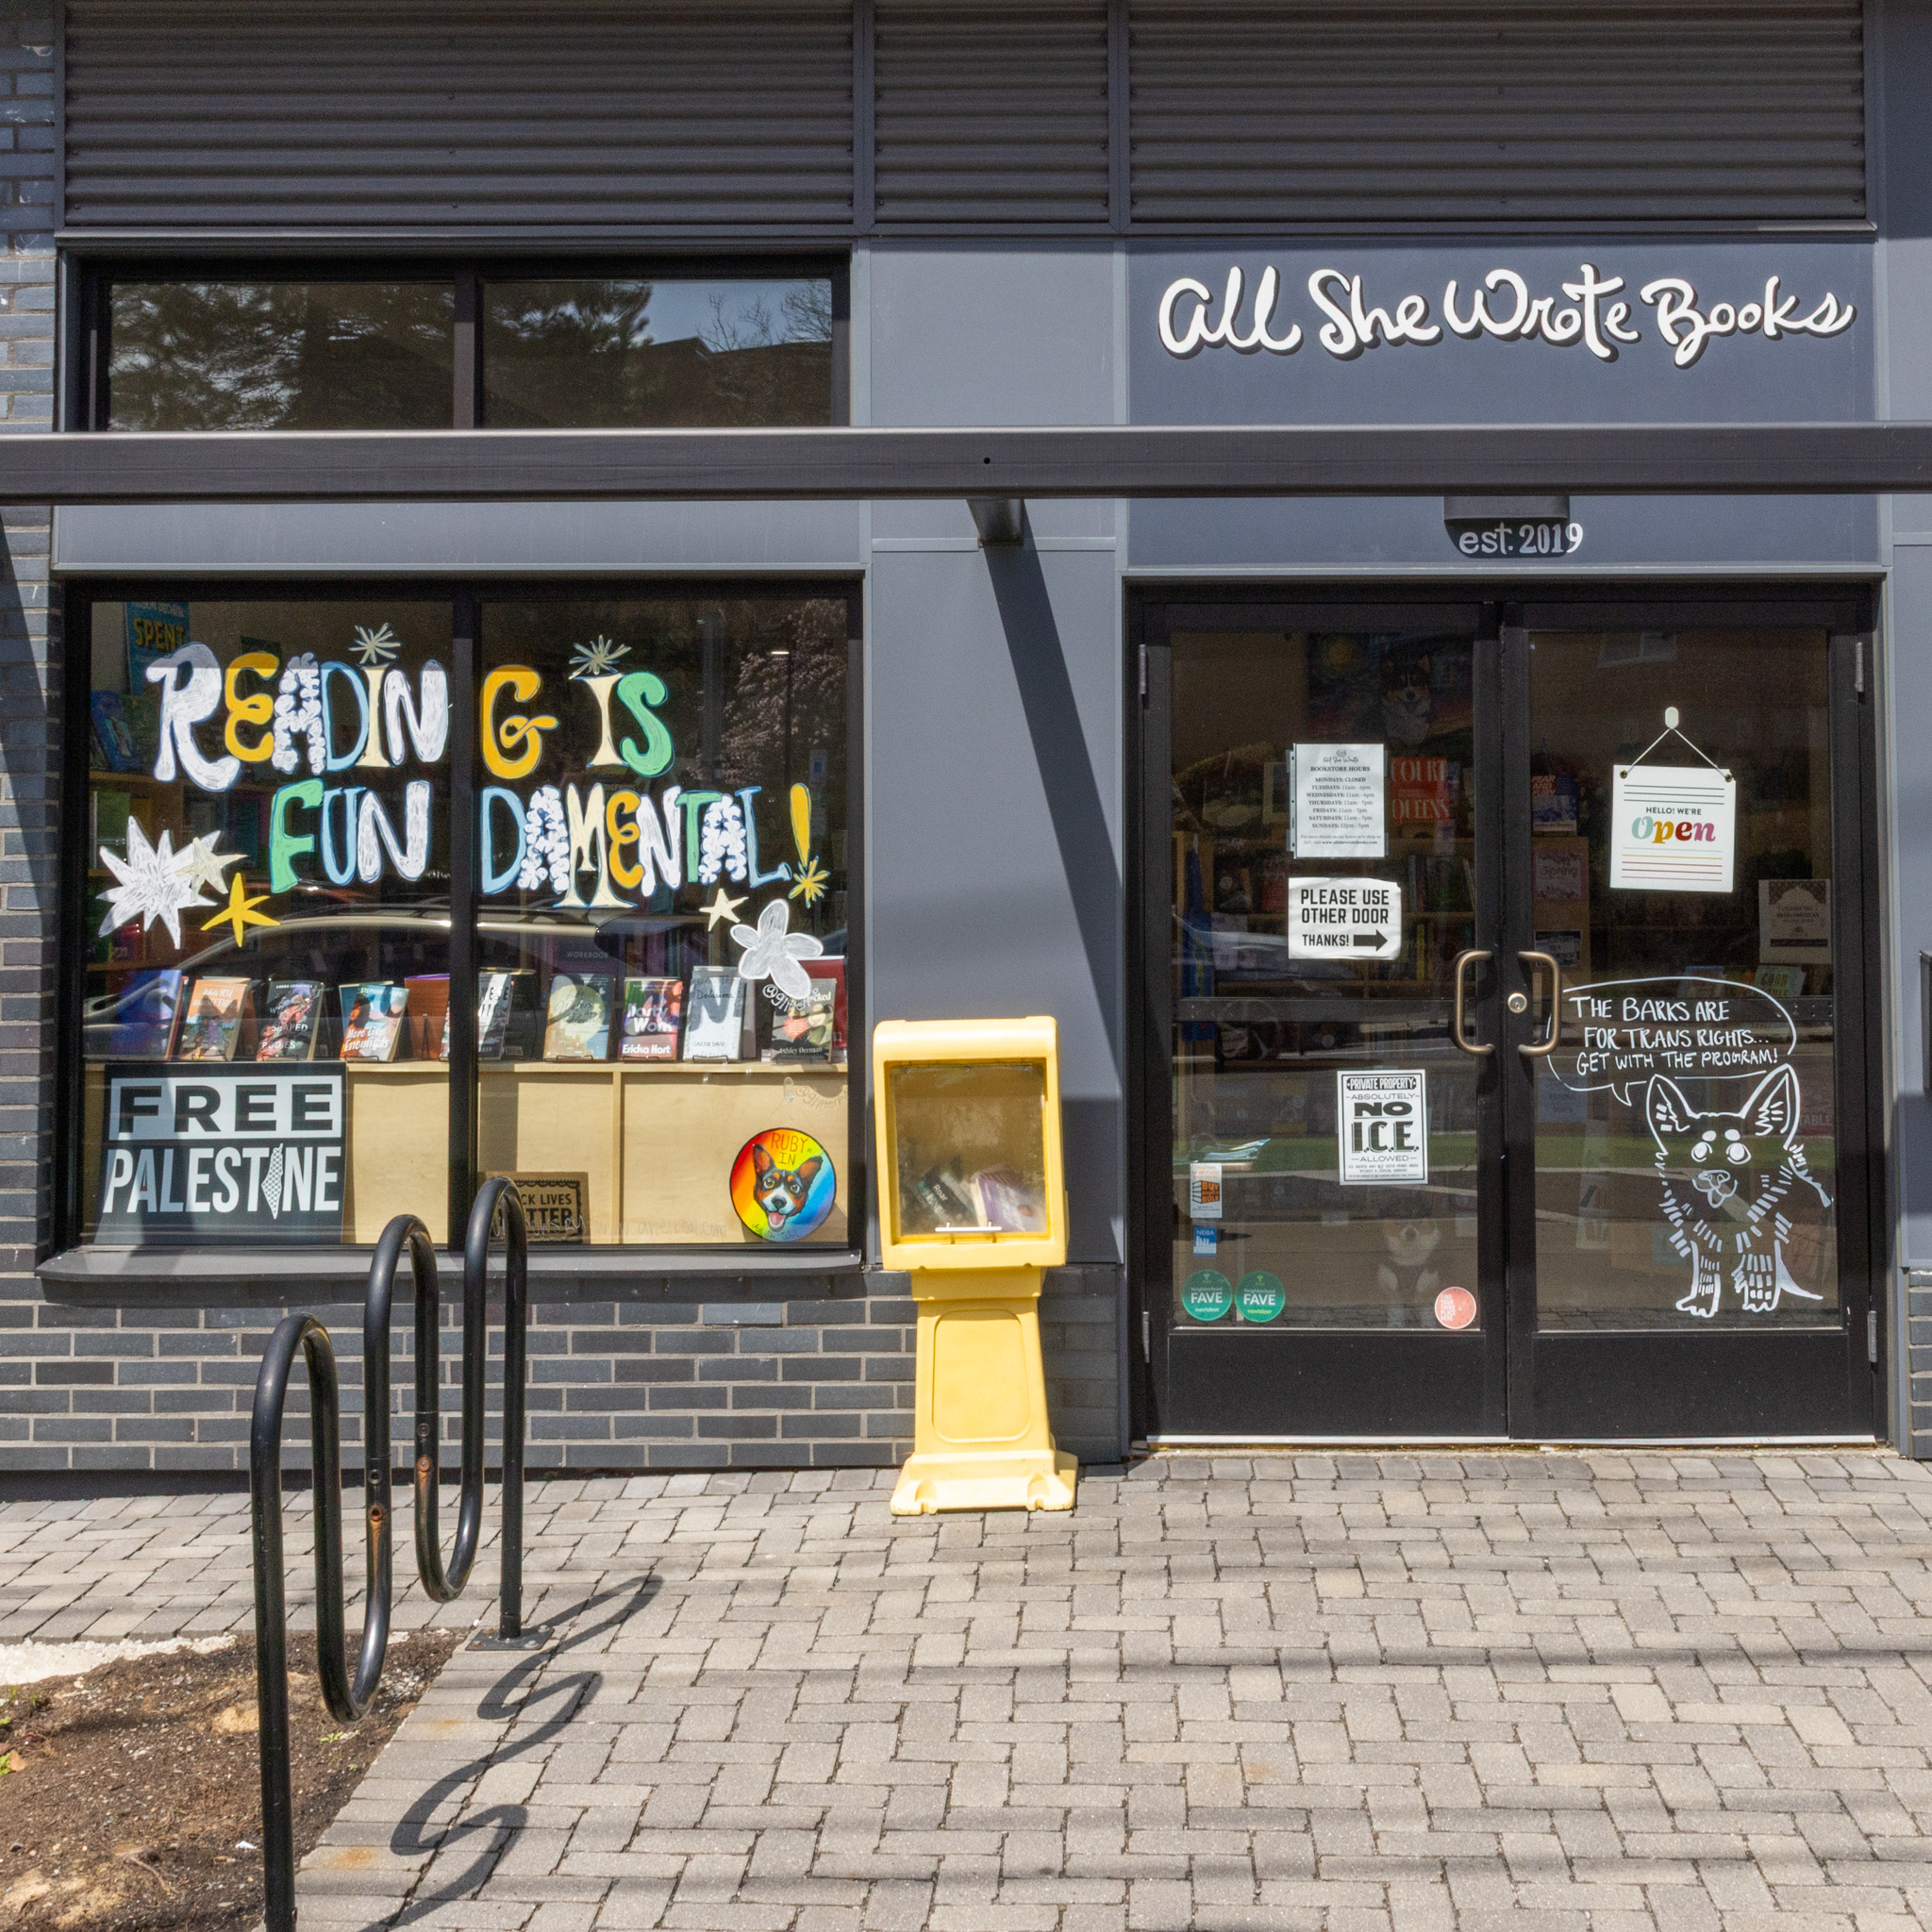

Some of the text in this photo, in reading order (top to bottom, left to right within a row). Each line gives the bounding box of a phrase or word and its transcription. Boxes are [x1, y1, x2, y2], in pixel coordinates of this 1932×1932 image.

[1308, 268, 1442, 359] She
[1443, 264, 1641, 361] Wrote
[1641, 275, 1856, 368] Books
[1457, 522, 1584, 556] est. 2019
[133, 616, 185, 653] SPENT
[568, 670, 675, 778] IS
[1645, 807, 1675, 815] HELLO!
[1631, 816, 1716, 844] Open
[1301, 889, 1390, 906] PLEASE USE
[1301, 908, 1389, 924] OTHER DOOR
[1302, 934, 1349, 946] THANKS!
[1569, 996, 1730, 1022] THE BARKS ARE
[346, 1029, 366, 1040] More
[1584, 1026, 1621, 1050] FOR
[1622, 1027, 1692, 1049] TRANS
[651, 1042, 672, 1055] Hart
[1576, 1047, 1779, 1076] GET WITH THE PROGRAM!
[1350, 1077, 1414, 1091] PRIVATE PROPERTY
[118, 1084, 334, 1133] FREE
[1354, 1101, 1413, 1117] NO
[770, 1132, 808, 1154] RUBY
[1351, 1121, 1420, 1154] I.C.E.
[778, 1151, 796, 1166] IN
[539, 1193, 572, 1206] LIVES
[524, 1208, 572, 1227] TTER
[1191, 1291, 1224, 1304] FAVE
[1243, 1293, 1276, 1306] FAVE
